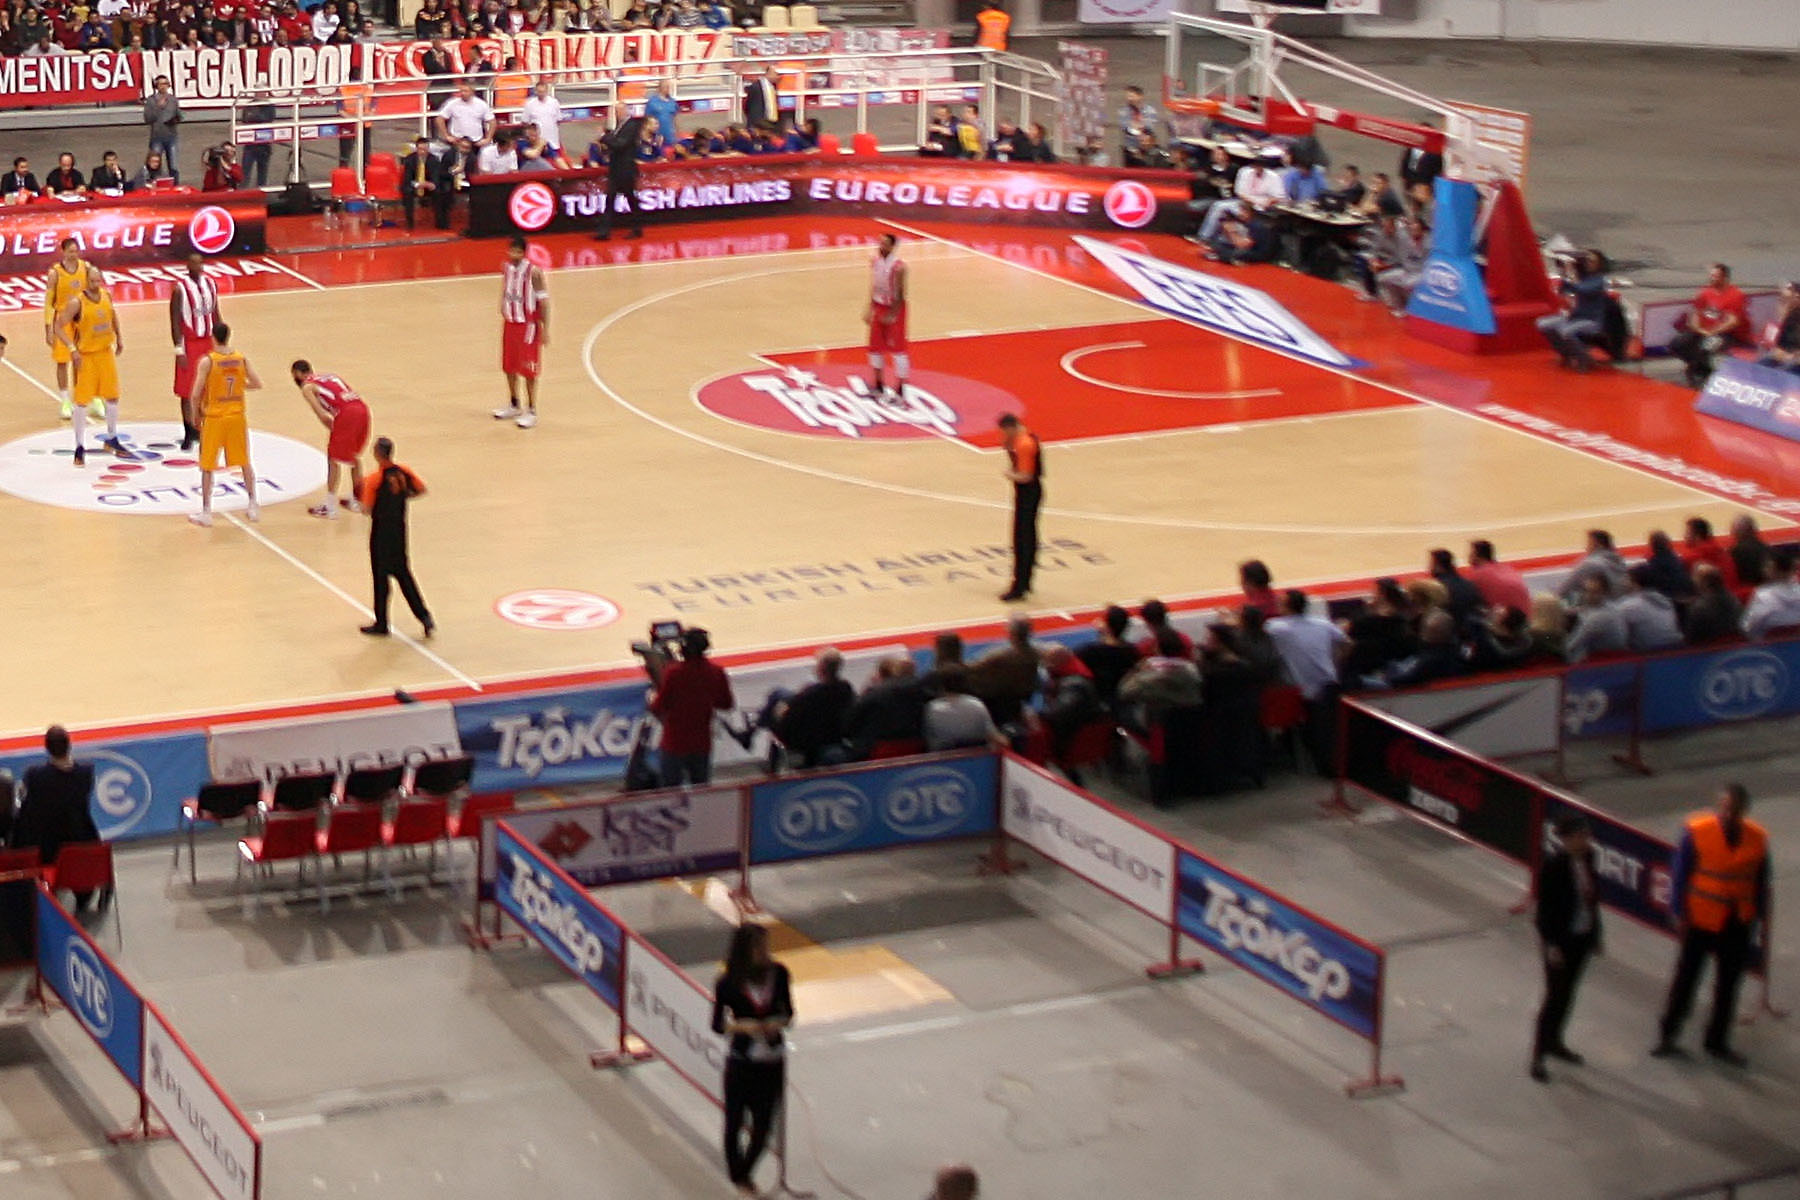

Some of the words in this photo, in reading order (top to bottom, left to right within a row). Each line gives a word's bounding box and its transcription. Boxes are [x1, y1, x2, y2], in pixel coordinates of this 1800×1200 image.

[683, 177, 792, 209] AIRLINES
[809, 177, 1092, 215] EUROLEAGUE
[637, 561, 865, 597] TURKISH
[164, 1070, 247, 1194] PEUGEOT
